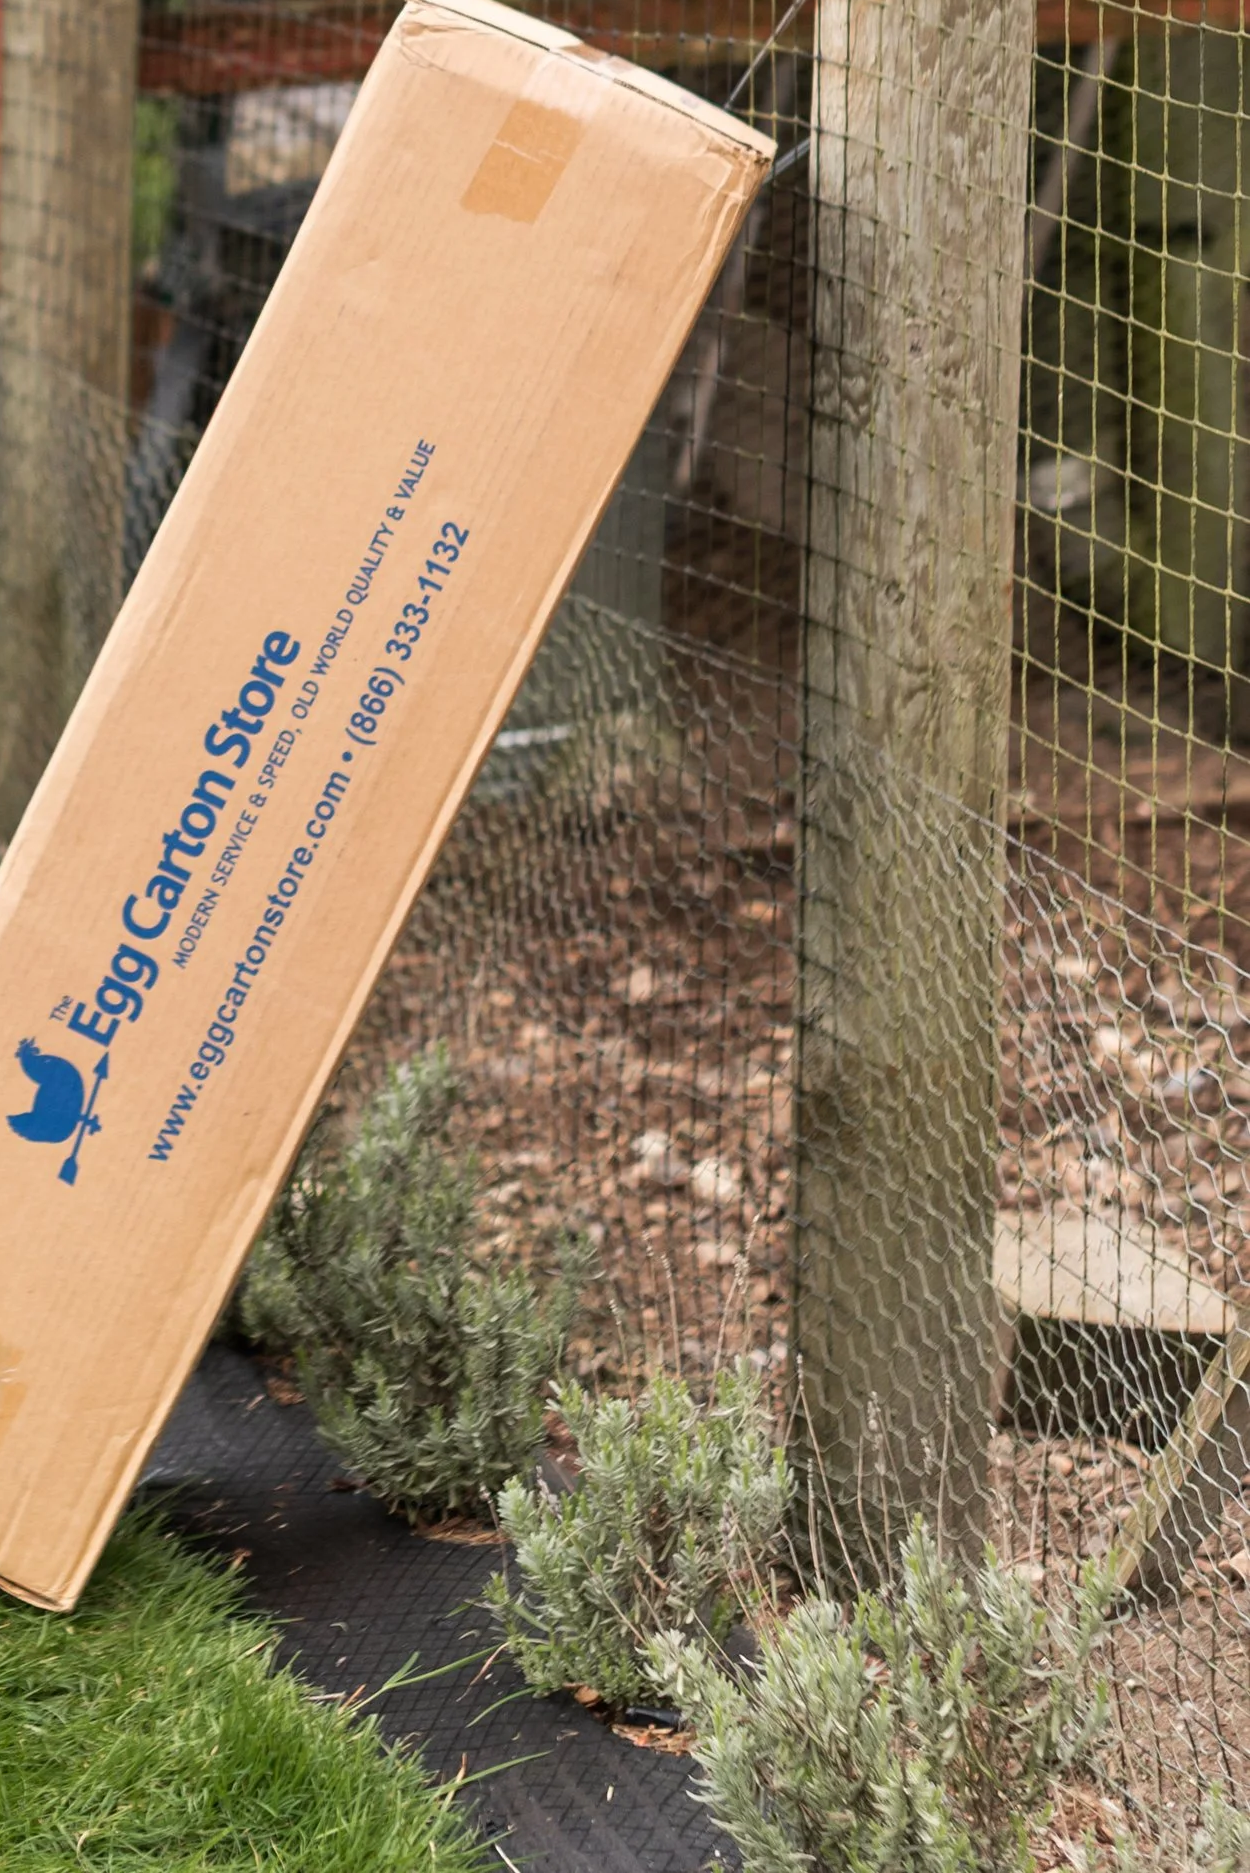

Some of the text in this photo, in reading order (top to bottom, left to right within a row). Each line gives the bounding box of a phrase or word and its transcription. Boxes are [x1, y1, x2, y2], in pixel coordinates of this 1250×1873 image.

[65, 629, 302, 1048] Egg Carton Store
[146, 520, 470, 1163] www.eggcartonstore.com (866) 333-1132
[172, 438, 436, 969] MODERN SERVICE & SPEED, OLD WORLD QUALITY & VALUE
[49, 995, 74, 1022] The
